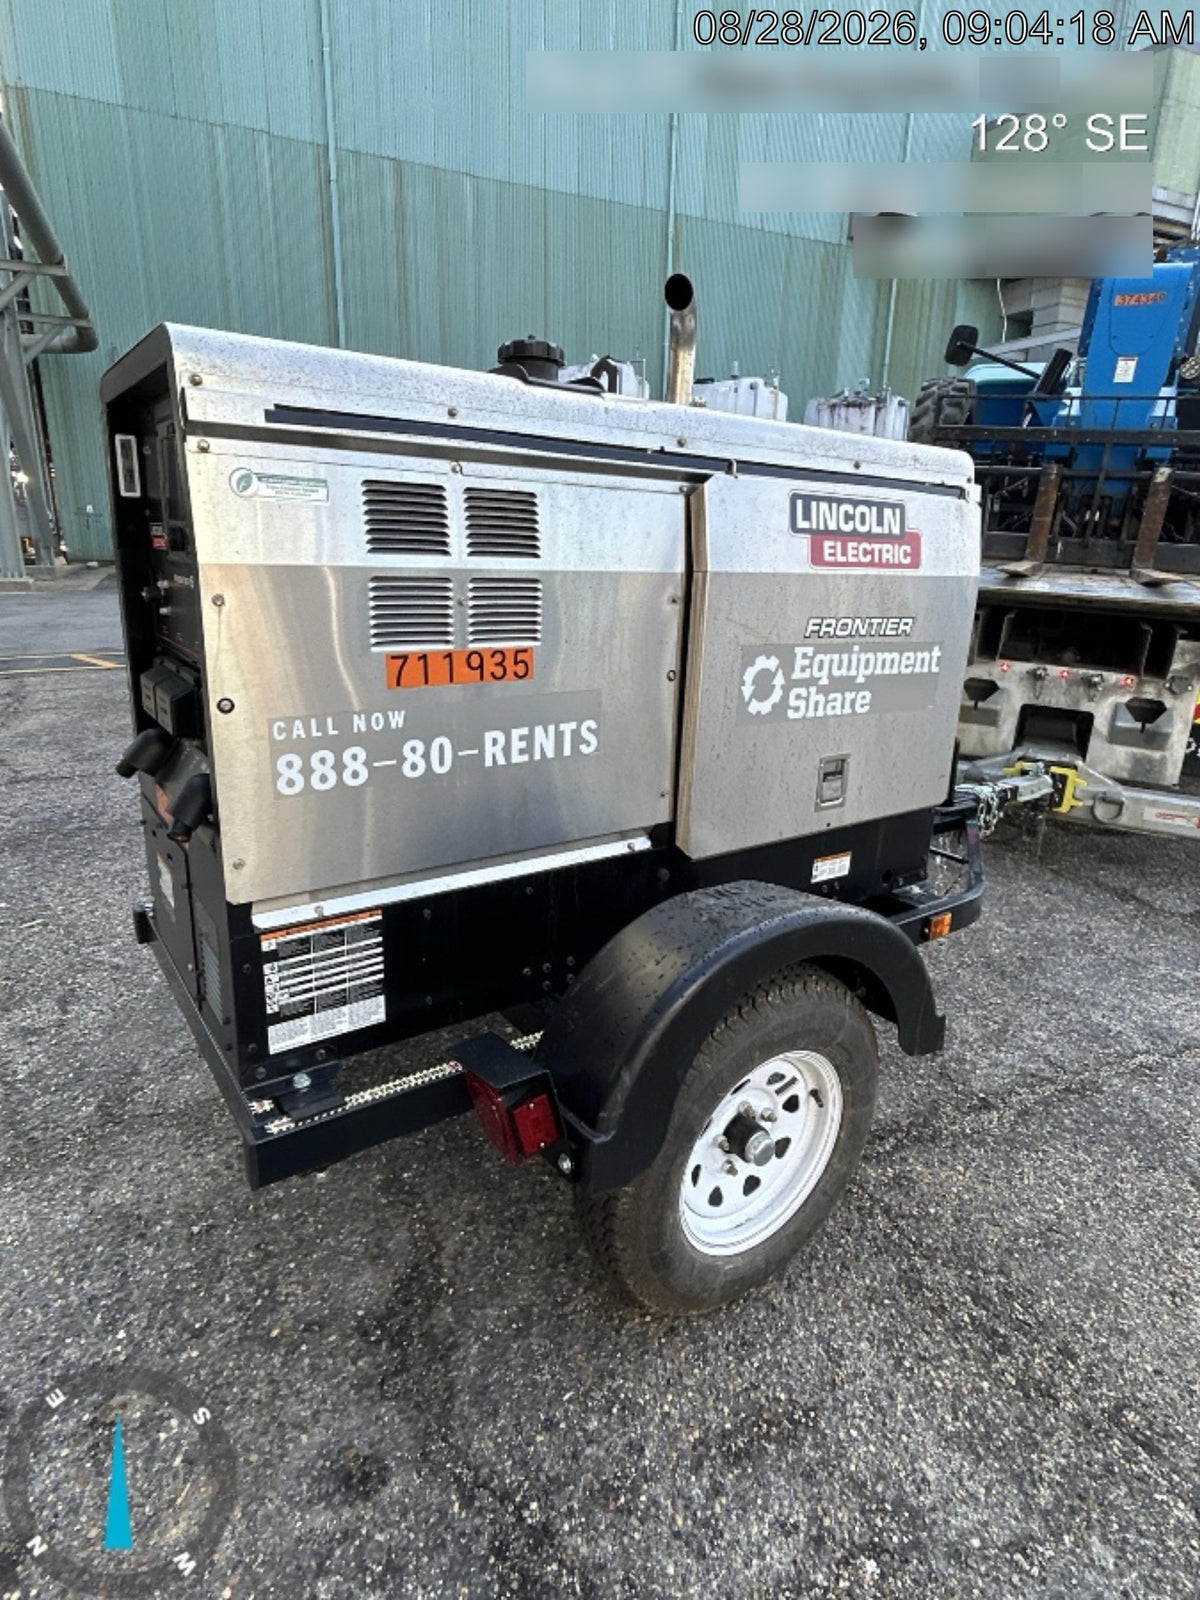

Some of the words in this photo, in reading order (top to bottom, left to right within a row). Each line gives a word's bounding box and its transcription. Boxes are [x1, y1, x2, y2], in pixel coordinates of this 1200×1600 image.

[795, 499, 902, 536] LINCOLN
[822, 540, 912, 566] ELECTRIC
[804, 617, 915, 638] FRONTIER
[389, 649, 531, 688] 711935
[790, 644, 941, 686] Equipment
[787, 687, 872, 719] Share
[272, 715, 339, 741] CALL
[353, 710, 407, 733] NOW
[275, 718, 600, 797] 888-80-RENTS
